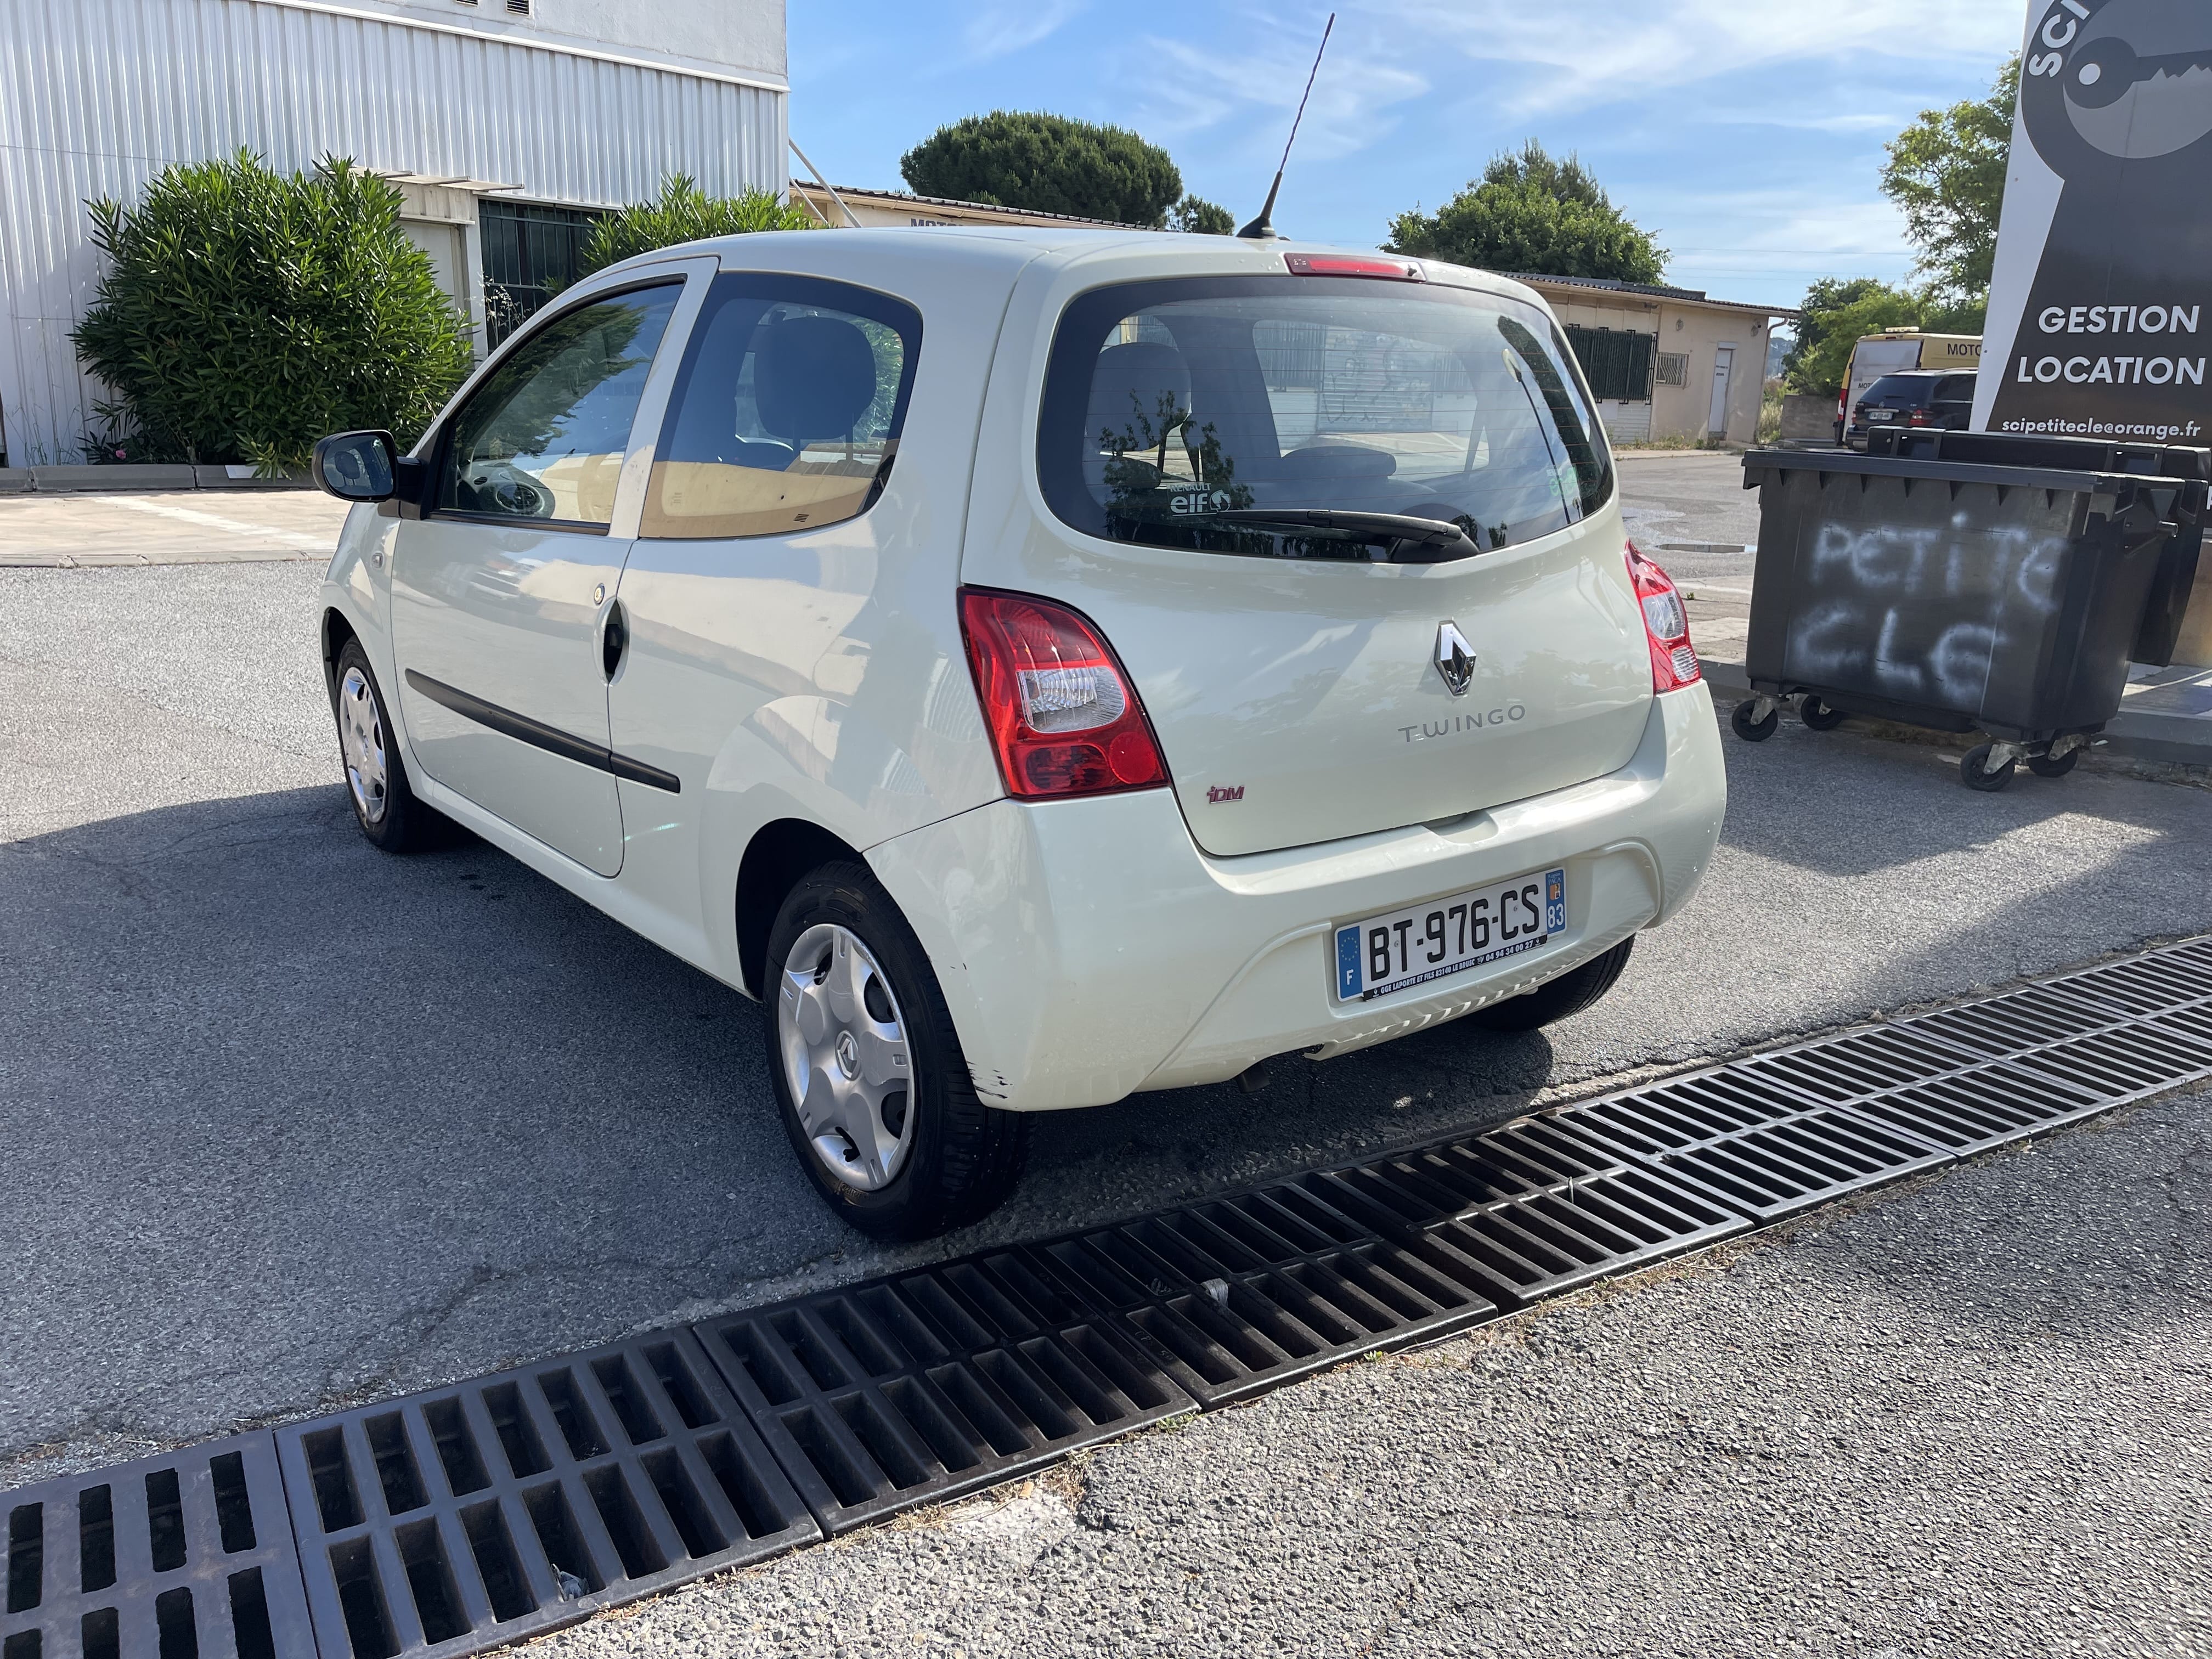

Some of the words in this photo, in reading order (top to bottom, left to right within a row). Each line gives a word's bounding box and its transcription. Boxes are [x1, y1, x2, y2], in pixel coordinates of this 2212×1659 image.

[2038, 305, 2200, 334] GESTION
[2017, 356, 2206, 385] LOCATION
[2002, 417, 2201, 441] scipetitecle@orange.fr
[1169, 483, 1211, 492] RENAULT
[1170, 493, 1208, 514] elf
[1397, 704, 1526, 742] TWINGO
[1547, 903, 1564, 928] 83
[1369, 884, 1540, 981] BT-976-CS
[1346, 969, 1354, 985] F
[1393, 977, 1416, 990] LAPORTE
[1417, 975, 1423, 983] ET
[1424, 971, 1435, 981] FILS
[1435, 966, 1452, 977] 83140
[1459, 958, 1475, 969] BRUSC
[1486, 953, 1494, 962] 04
[1496, 949, 1504, 958] 94
[1505, 946, 1514, 955] 34
[1515, 943, 1523, 952] 00
[1525, 940, 1533, 949] 27
